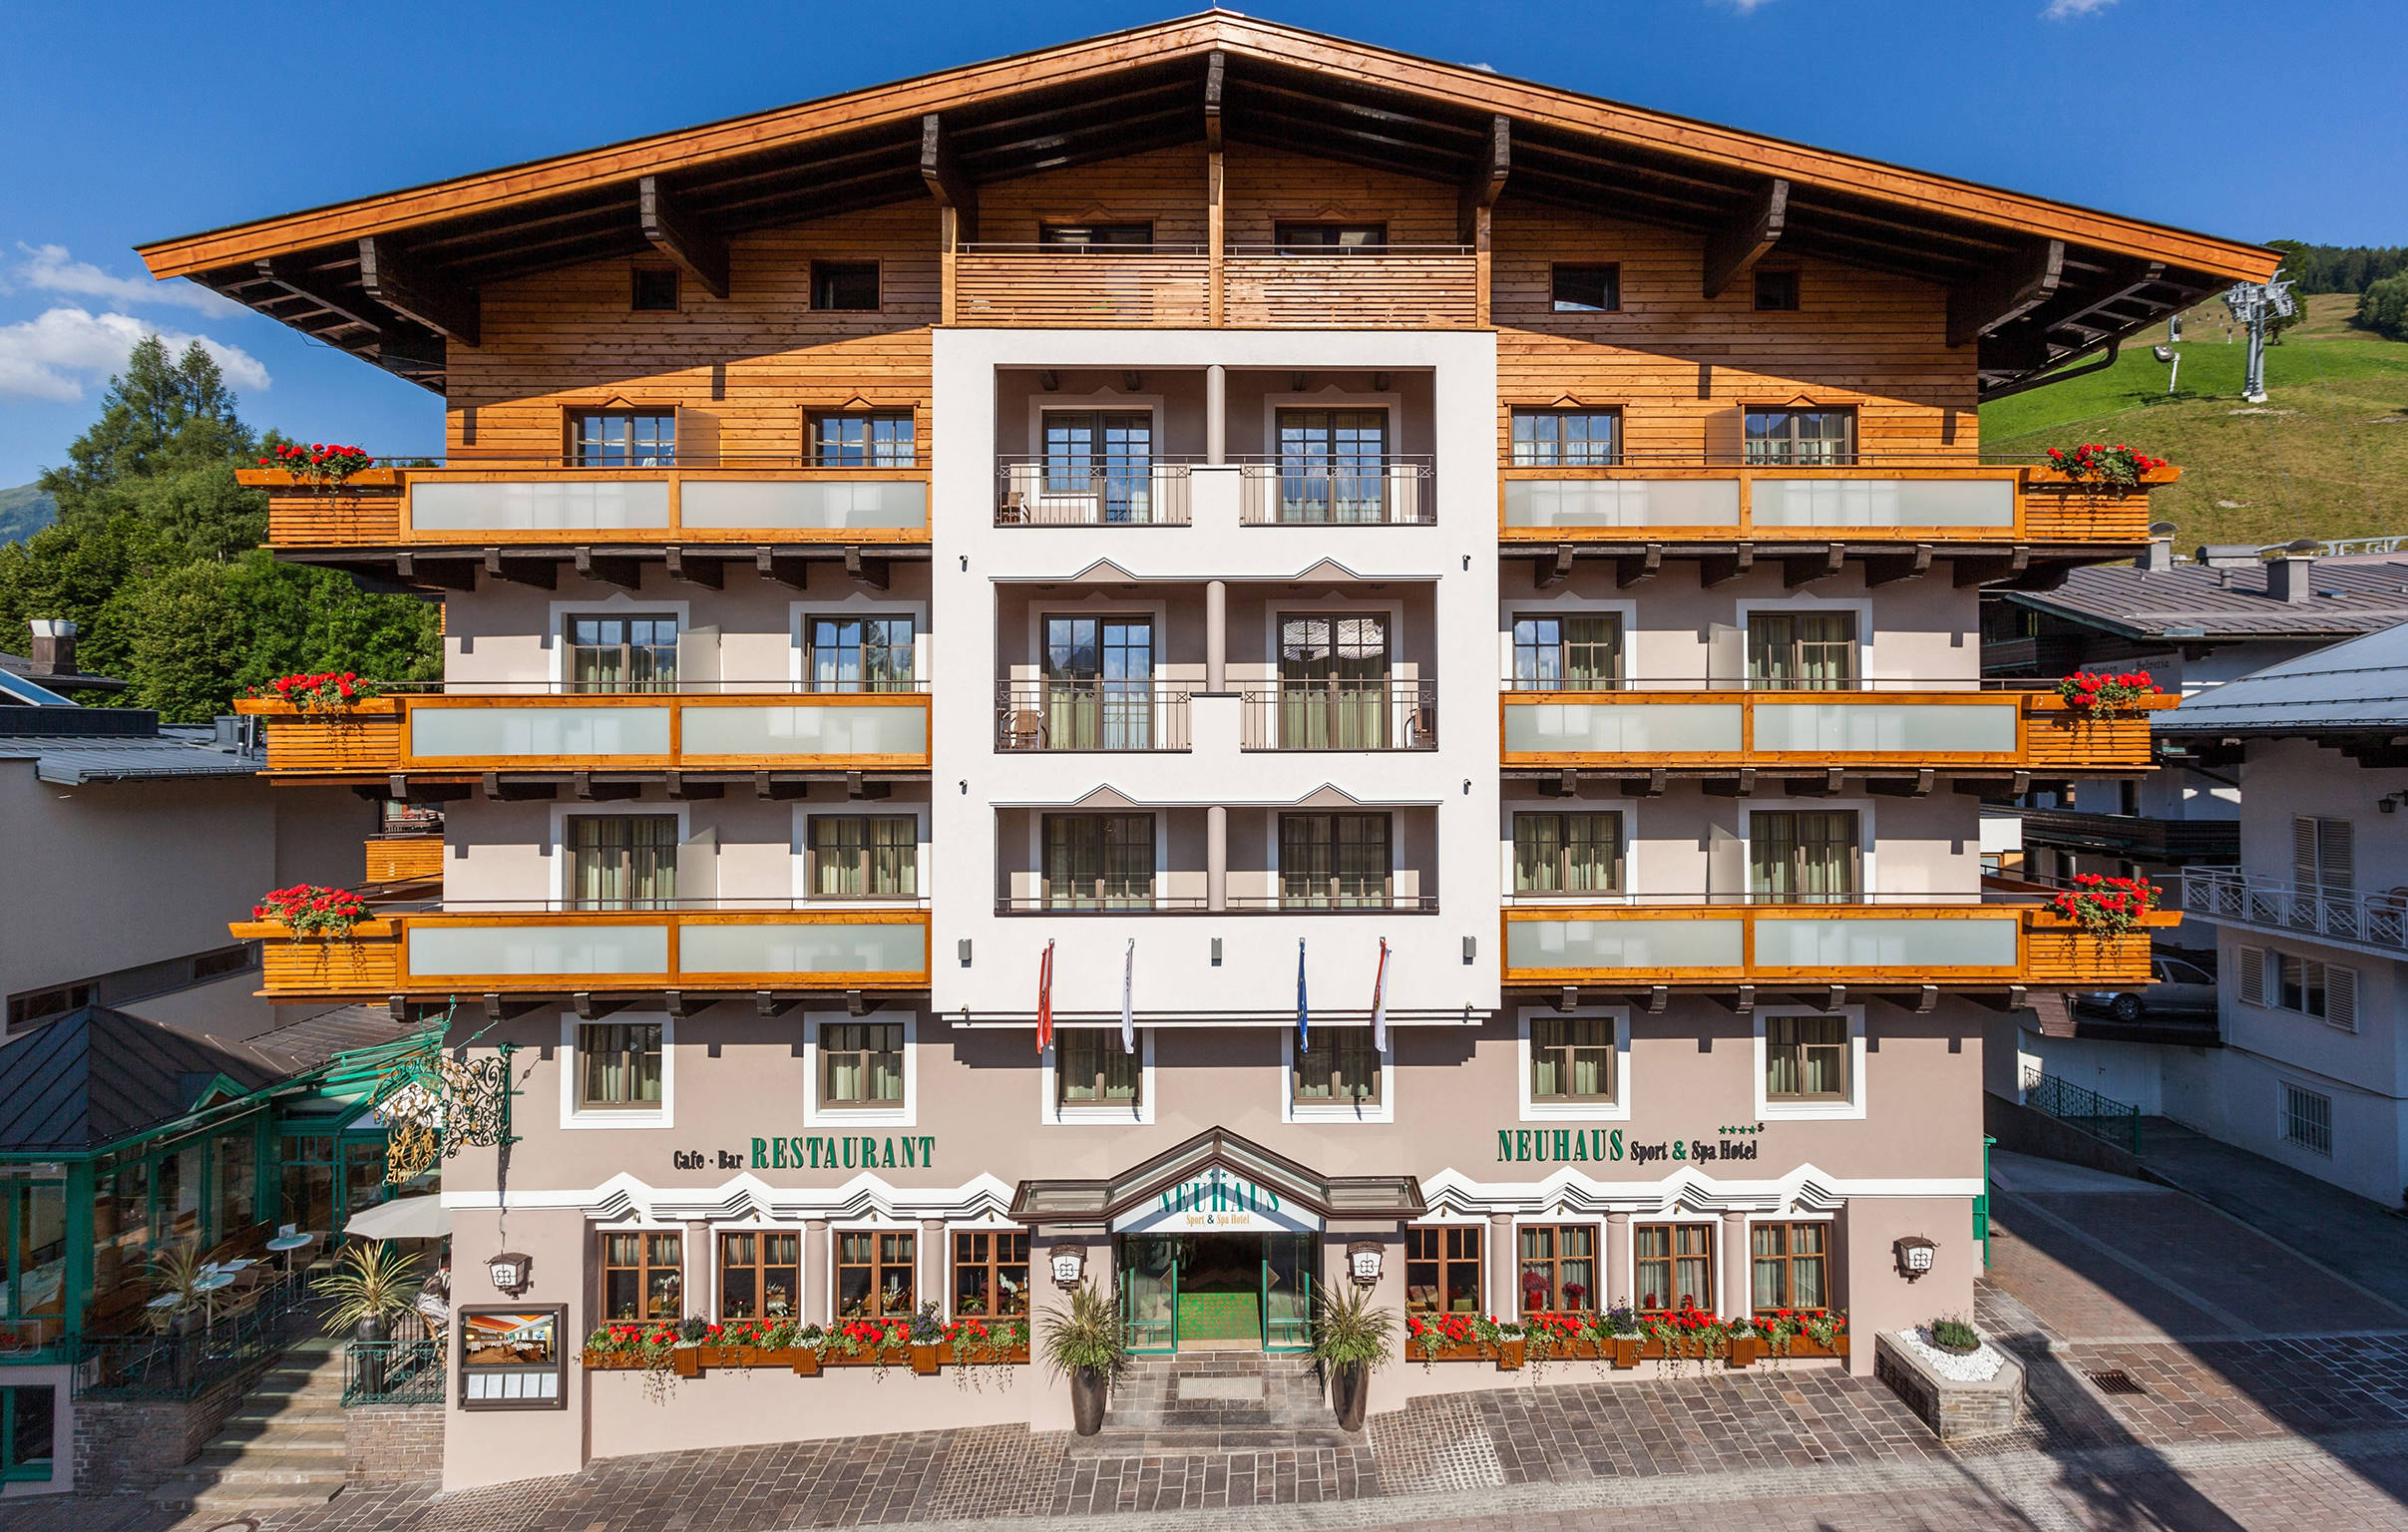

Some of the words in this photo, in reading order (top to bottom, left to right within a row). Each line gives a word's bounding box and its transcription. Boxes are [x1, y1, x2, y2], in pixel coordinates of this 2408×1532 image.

[673, 1150, 704, 1169] Cafe
[718, 1150, 743, 1169] Bar
[750, 1136, 935, 1169] RESTAURANT
[1496, 1129, 1623, 1162] NEUHAUS
[1630, 1141, 1668, 1165] Sport
[1672, 1140, 1687, 1160] &
[1691, 1140, 1717, 1165] Spa
[1719, 1140, 1758, 1160] Hotel
[1157, 1183, 1280, 1212] NEUHAUS
[1187, 1214, 1205, 1227] Sport
[1207, 1214, 1214, 1225] &
[1217, 1214, 1229, 1226] Spa
[1231, 1214, 1250, 1225] Hotel
